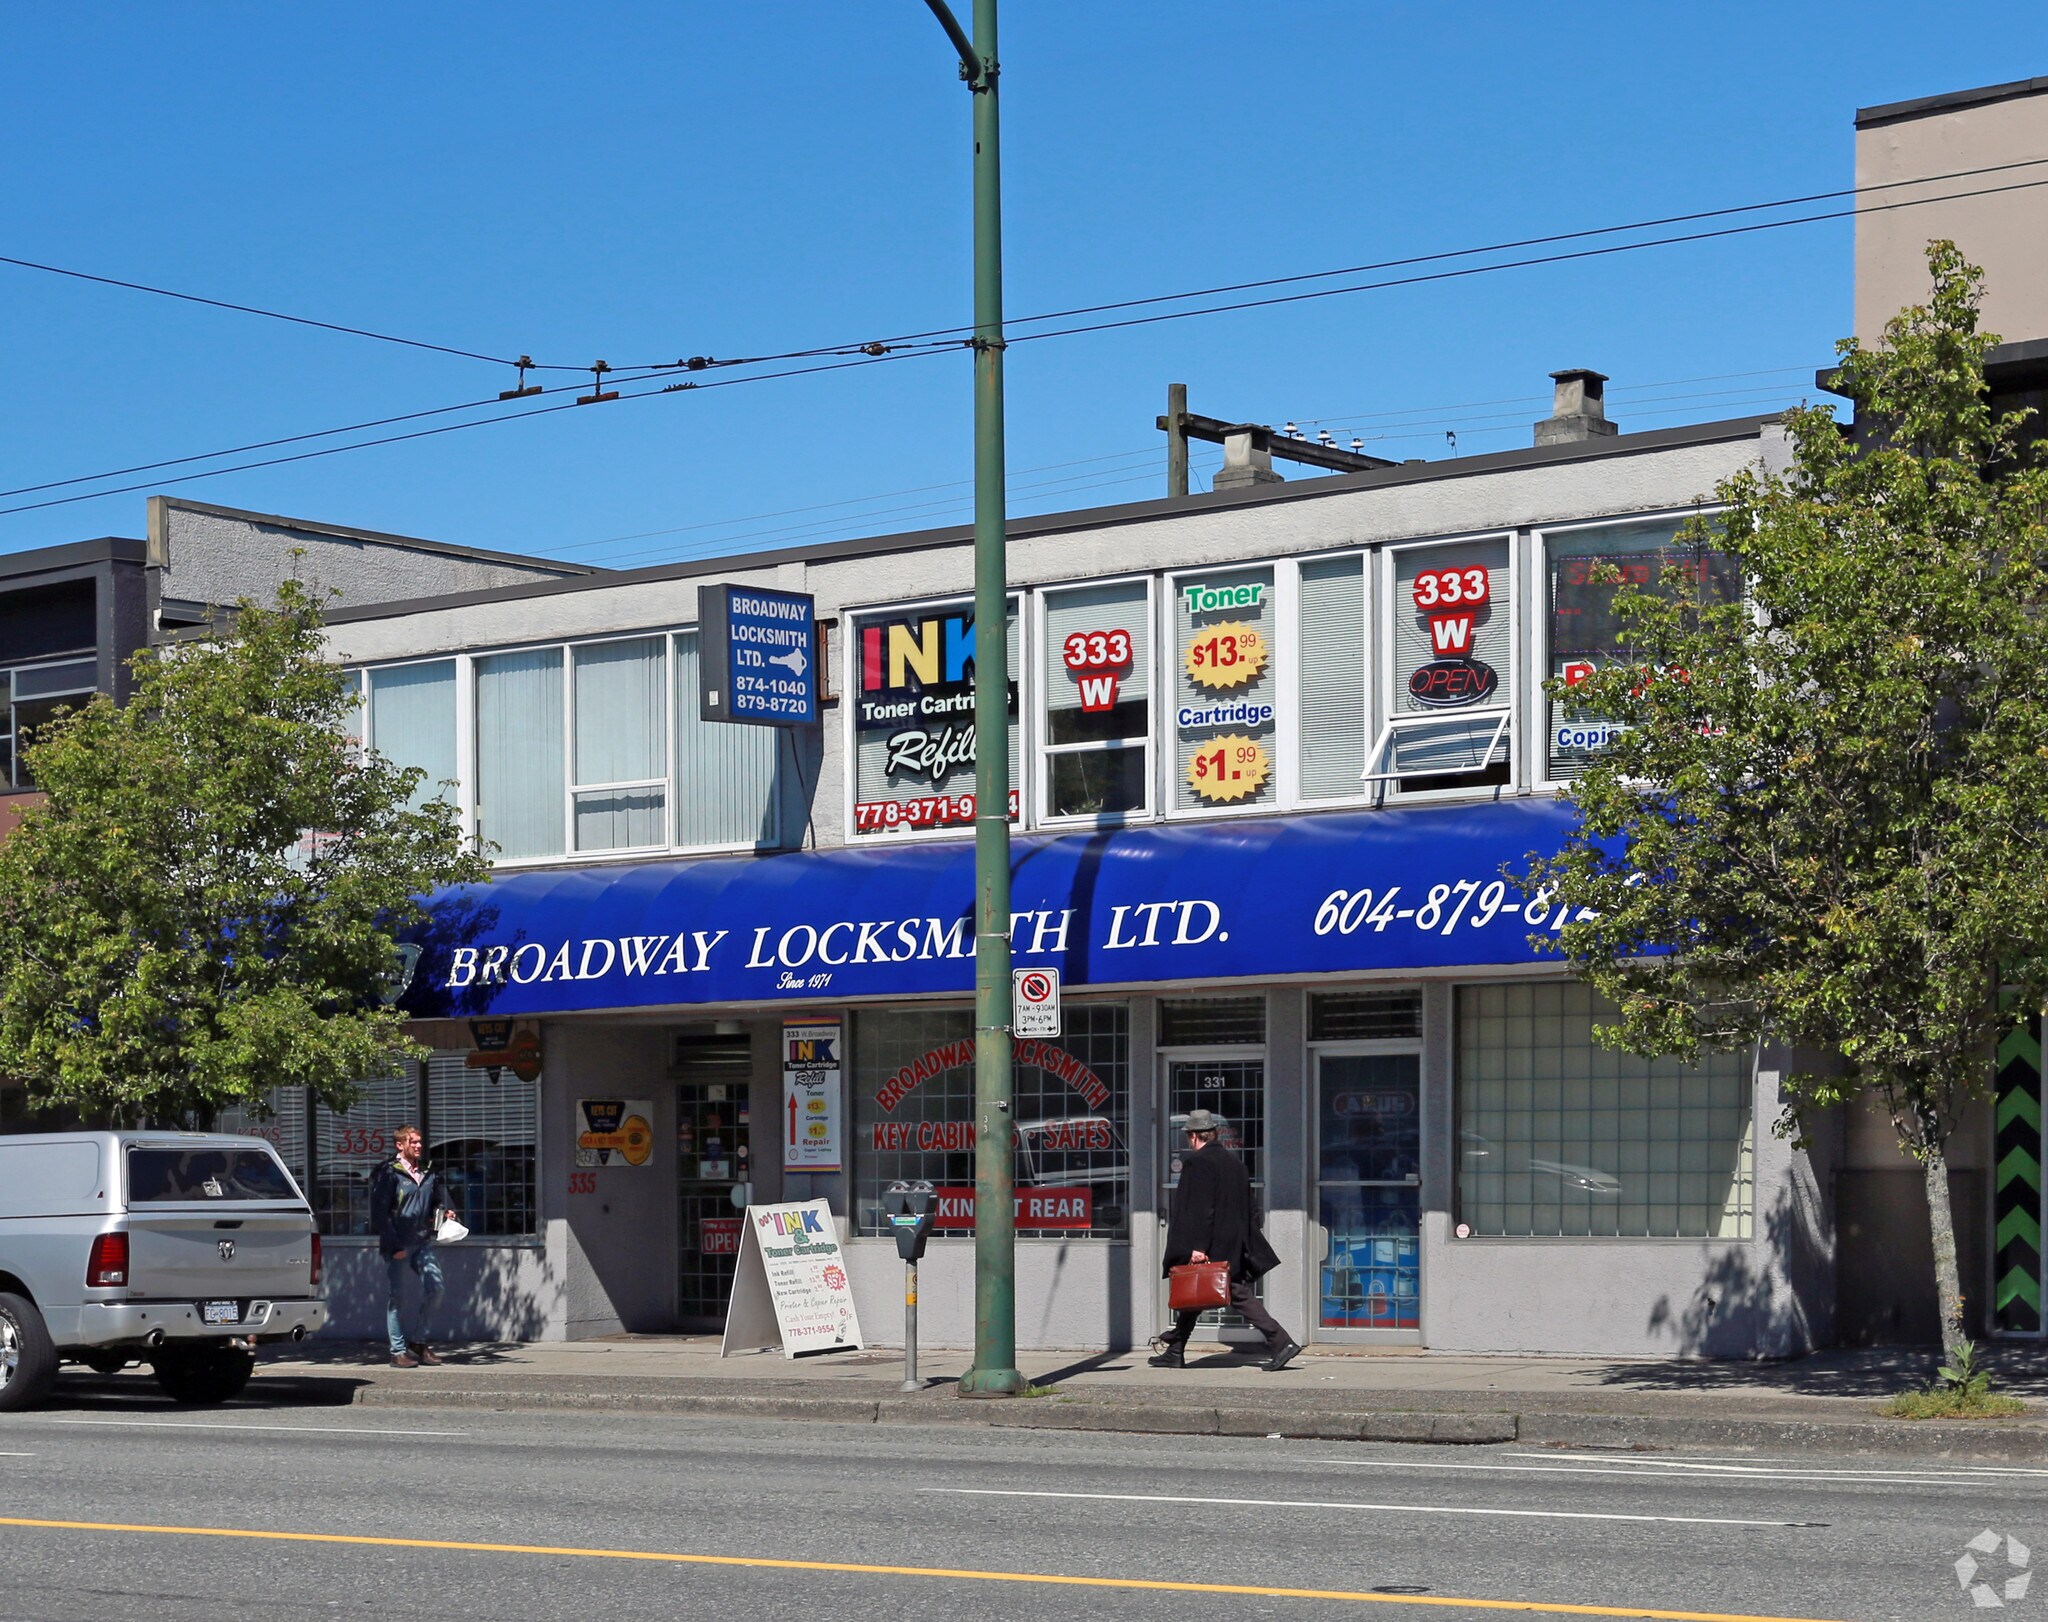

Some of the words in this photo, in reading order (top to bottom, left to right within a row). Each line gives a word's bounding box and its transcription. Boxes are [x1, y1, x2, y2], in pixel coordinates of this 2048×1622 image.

[1186, 585, 1262, 610] Toner
[1417, 571, 1485, 605] 333
[732, 597, 806, 621] BROADWAY
[731, 624, 807, 648] LOCKSMITH
[1433, 619, 1469, 649] W
[737, 649, 765, 667] LTD.
[1067, 634, 1128, 666] 333
[736, 676, 806, 695] 874-1040
[1081, 677, 1113, 706] W
[1410, 669, 1489, 692] OPEN
[737, 695, 807, 713] 879-8720
[862, 700, 914, 721] Toner
[920, 692, 1012, 715] Cartri
[1178, 704, 1272, 725] Cartridge
[1557, 726, 1618, 748] Copi
[856, 794, 1018, 827] 778-371-94
[1314, 872, 1646, 936] 604-879-8
[445, 930, 729, 988] BROADWAY
[744, 908, 1078, 969] LOCKSMTH
[1102, 899, 1228, 949] LTD.
[776, 971, 805, 989] Since
[808, 973, 832, 989] 1971
[790, 1039, 835, 1061] INK
[806, 1061, 837, 1070] Cartridge
[1012, 1037, 1111, 1110] OCKSMITH
[796, 1072, 824, 1088] Refill
[1204, 1076, 1226, 1088] 331
[337, 1128, 385, 1155] 335
[803, 1139, 830, 1147] Repair
[873, 1121, 912, 1150] KEY
[917, 1121, 1019, 1150] CABIN
[1044, 1119, 1111, 1149] SAFES
[568, 1173, 597, 1193] 335
[1030, 1199, 1085, 1217] REAR
[773, 1210, 823, 1236] INK
[794, 1228, 810, 1244] &
[764, 1246, 793, 1258] Toner
[794, 1243, 838, 1256] Cartridge
[780, 1299, 801, 1310] Printer
[804, 1299, 810, 1308] &
[811, 1298, 828, 1309] Copier
[830, 1295, 848, 1307] Repair
[788, 1288, 812, 1296] Cartridge
[785, 1314, 800, 1323] Cash
[800, 1313, 814, 1322] Your
[788, 1324, 835, 1337] 778-371-9554
